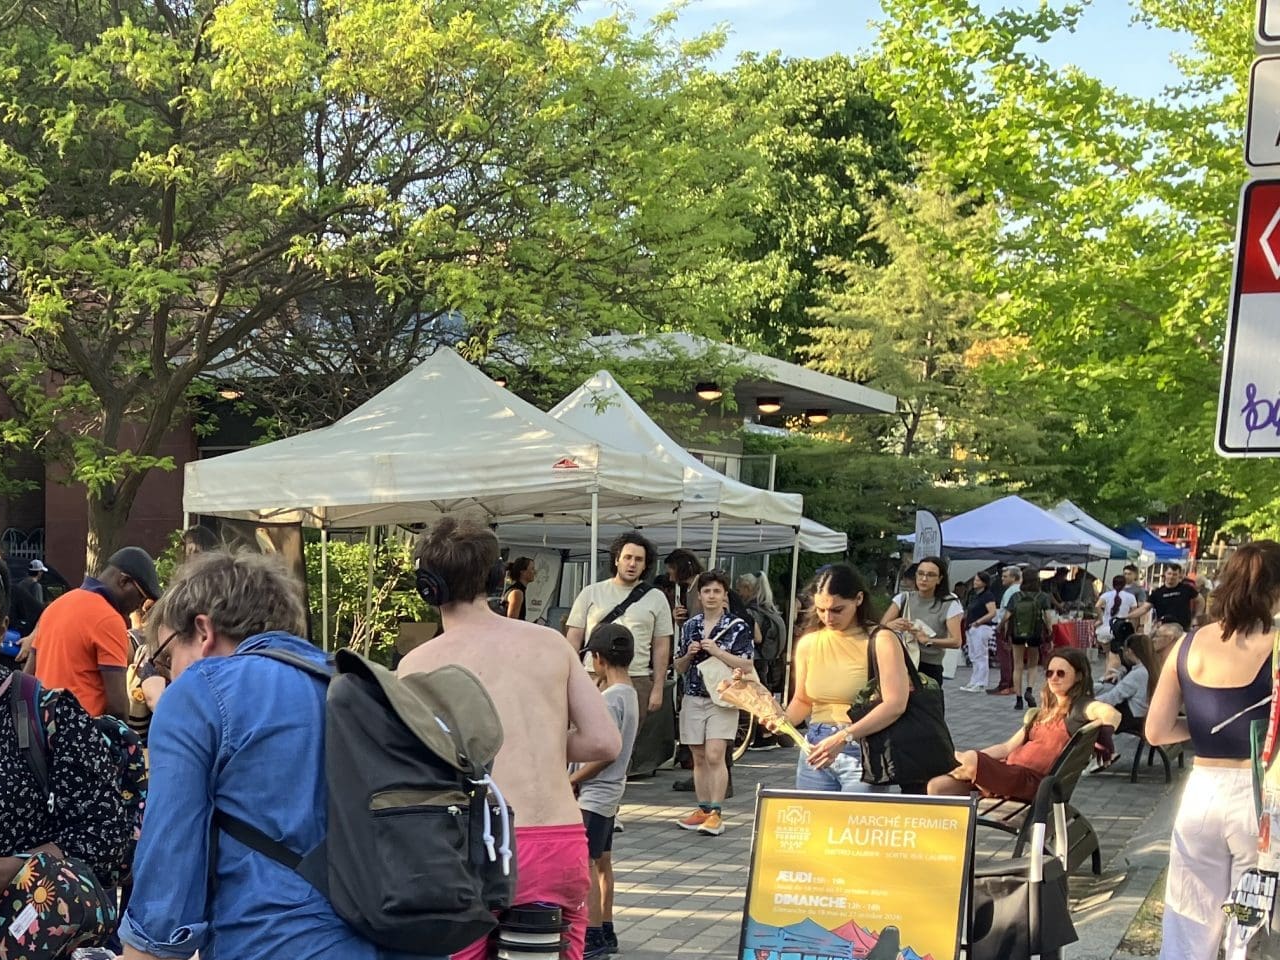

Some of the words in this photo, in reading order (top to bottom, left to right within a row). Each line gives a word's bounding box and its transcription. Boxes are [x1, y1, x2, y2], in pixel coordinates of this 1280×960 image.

[847, 814, 901, 828] MARCHÉ
[904, 817, 958, 830] FERMIER
[827, 827, 917, 849] LAURIER
[776, 870, 813, 884] JEUDI
[774, 893, 848, 909] DIMANCHE
